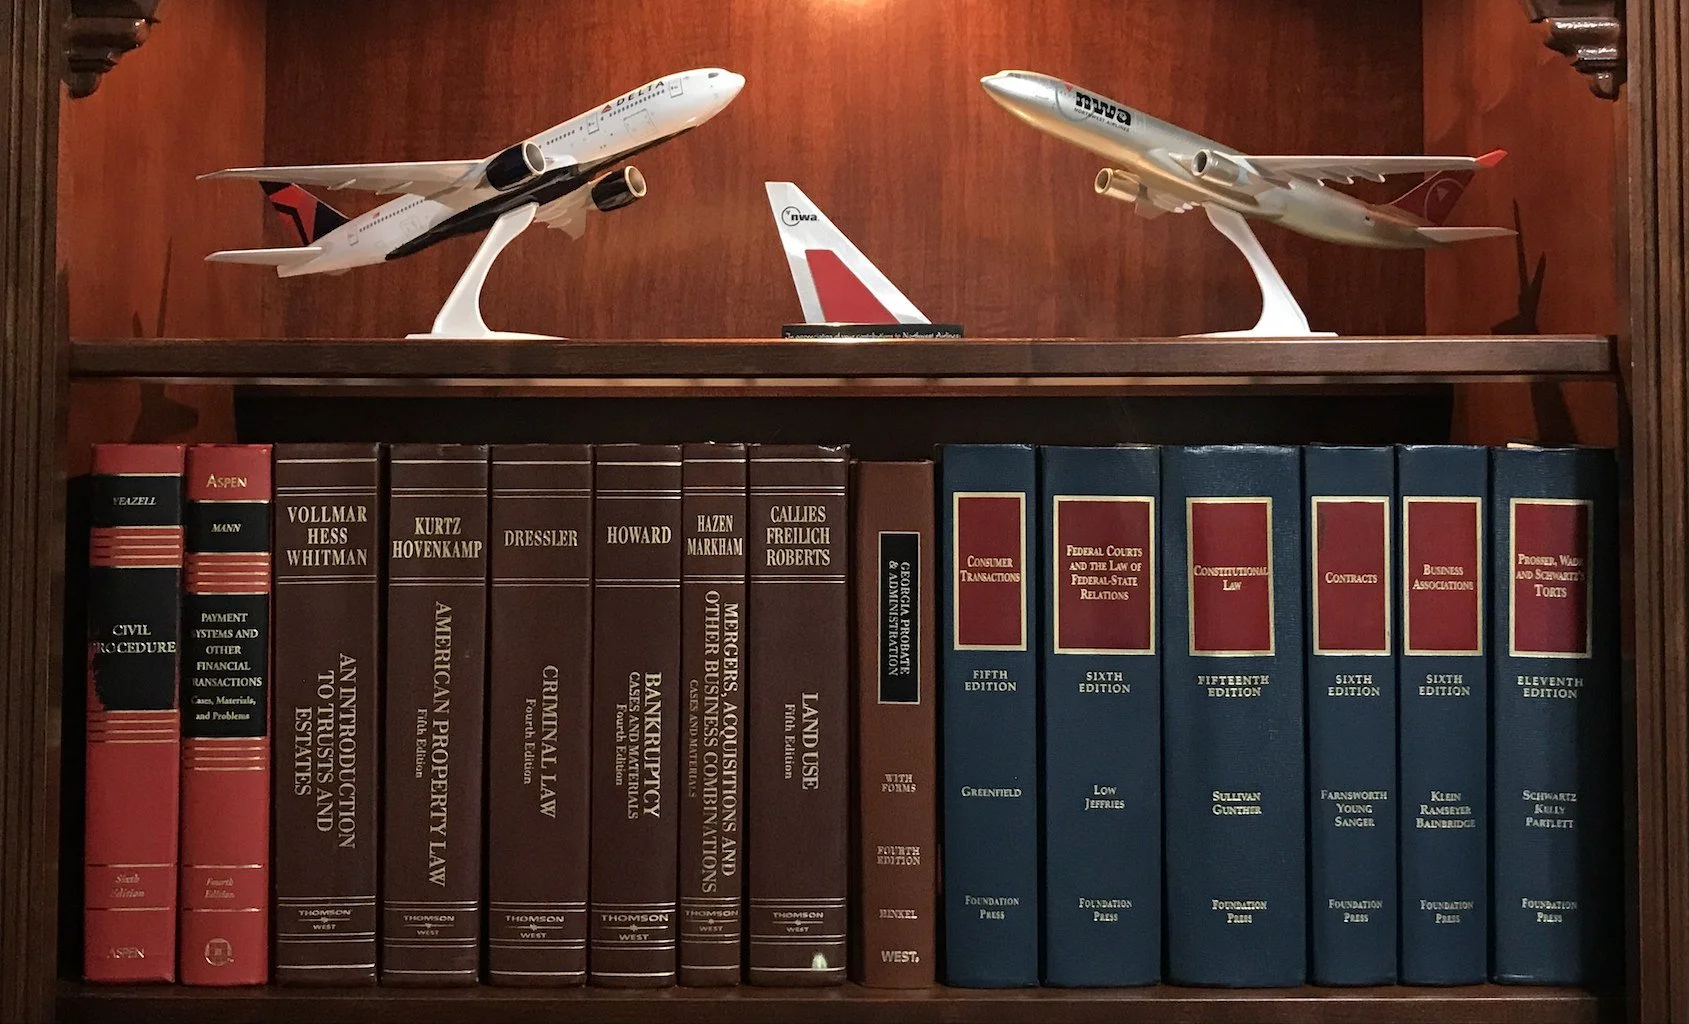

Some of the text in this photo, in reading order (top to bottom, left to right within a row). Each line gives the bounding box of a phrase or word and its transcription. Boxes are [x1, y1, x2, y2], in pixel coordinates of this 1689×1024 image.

[616, 80, 665, 106] DELTA
[1075, 91, 1132, 126] nwa
[206, 474, 248, 488] ASPEN
[113, 496, 157, 506] YEAZELL
[287, 505, 368, 523] VOLLMAR
[770, 505, 827, 523] CALLIES
[211, 523, 241, 533] MANN
[414, 516, 462, 536] KURTZ
[697, 514, 734, 533] HAZEN
[307, 527, 348, 545] HESS
[504, 529, 578, 547] DRESSLER
[606, 525, 672, 545] HOWARD
[766, 527, 831, 545] FREILICH
[392, 540, 483, 559] HOVENKAMP
[686, 537, 744, 556] MARKHAM
[1066, 544, 1143, 558] FEDERAL COURTS
[287, 548, 368, 566] WHITMAN
[766, 548, 831, 567] ROBERTS
[966, 555, 1013, 568] CONSUMER
[1069, 560, 1142, 572] AND THE LAW OF
[1193, 565, 1268, 577] CONSTITUTIONAL
[1423, 564, 1463, 576] BUSINESS
[960, 569, 1021, 583] TRANSACTIONS
[1070, 574, 1138, 587] FEDERAL-STATE
[1325, 571, 1378, 584] CONTRACTS
[1515, 570, 1534, 580] AND
[1222, 579, 1242, 591] LAW
[1412, 578, 1474, 591] ASSOCIATIONS
[1533, 583, 1568, 598] TORTS
[1080, 588, 1129, 600] RELATIONS
[201, 612, 248, 623] PAYMENT
[888, 560, 899, 677] & ADMINISTRATION
[900, 561, 911, 675] GEORGIA PROBATE
[113, 624, 152, 636] CIVIL
[235, 628, 259, 638] AND
[91, 641, 177, 653] ROCEDURE
[205, 645, 242, 655] OTHER
[196, 661, 251, 671] FINANCIAL
[973, 669, 1008, 680] FIFTH
[1086, 671, 1123, 682] SIXTH
[1197, 675, 1270, 686] FIFTEENTH
[1335, 674, 1373, 685] SIXTH
[1426, 674, 1463, 684] SIXTH
[192, 677, 263, 687] RANSACTIONS
[964, 681, 1017, 692] EDITION
[1517, 676, 1584, 688] ELEVENTH
[1079, 683, 1131, 694] EDITION
[1208, 686, 1261, 697] EDITION
[1328, 686, 1380, 696] EDITION
[1418, 686, 1470, 696] EDITION
[1523, 688, 1577, 699] EDITION
[216, 695, 257, 705] Materials,
[196, 711, 250, 720] and Problems
[415, 708, 428, 779] Fifth Edition
[428, 600, 452, 888] AMERICAN PROPERTY LAW
[523, 698, 537, 785] Fourth Edition
[539, 664, 559, 818] CRIMINAL LAW
[688, 678, 700, 798] CASES AND MATERIALS
[701, 589, 721, 893] OTHER BUSINESS COMBINATIONS
[720, 602, 739, 877] MERGERS, ACQUISITIONS AND
[784, 703, 797, 780] Fifth Edition
[801, 692, 820, 790] LAND USE
[316, 669, 335, 832] TO TRUSTS AND
[337, 652, 357, 849] AN INTRODUCTION
[615, 703, 628, 786] Fourth Edition
[627, 671, 641, 820] CASES AND MATERIALS
[643, 671, 663, 818] BANKRUPTCY
[294, 706, 313, 796] ESTATES
[884, 773, 913, 783] WITH
[881, 783, 917, 793] FORMS
[961, 785, 1022, 798] GREENFIELD
[1093, 784, 1117, 795] LOW
[1212, 791, 1261, 802] SULLIVAN
[1320, 789, 1387, 800] FARNSWORTH
[1430, 791, 1461, 802] KLEIN
[1522, 790, 1577, 802] SCHWARTZ
[1084, 797, 1125, 810] JEFFRIES
[1212, 804, 1262, 815] GUNTHER
[1336, 803, 1372, 814] YOUNG
[1420, 804, 1471, 815] RAMSEYER
[1334, 816, 1375, 827] SANGER
[1416, 818, 1475, 828] BAINBRIDGE
[1525, 817, 1574, 828] PARTLETT
[877, 846, 920, 856] FOURTH
[877, 856, 921, 865] EDITION
[205, 877, 235, 887] Fourth
[965, 895, 1019, 906] FOUNDATION
[1079, 897, 1132, 909] FOUNDATION
[1212, 899, 1267, 910] FOUNDATION
[1328, 899, 1382, 909] FOUNDATION
[1420, 900, 1474, 910] FOUNDATION
[1521, 898, 1577, 910] FOUNDATION
[299, 909, 351, 917] THOMSON
[505, 915, 565, 923] THOMSON
[601, 914, 669, 922] THOMSON
[684, 909, 739, 918] THOMSON
[772, 911, 824, 919] THOMSON
[979, 909, 1005, 920] PRESS
[1093, 911, 1118, 922] PRESS
[1227, 912, 1252, 923] PRESS
[1343, 912, 1369, 923] PRESS
[1435, 913, 1460, 924] PRESS
[1537, 911, 1562, 923] PRESS
